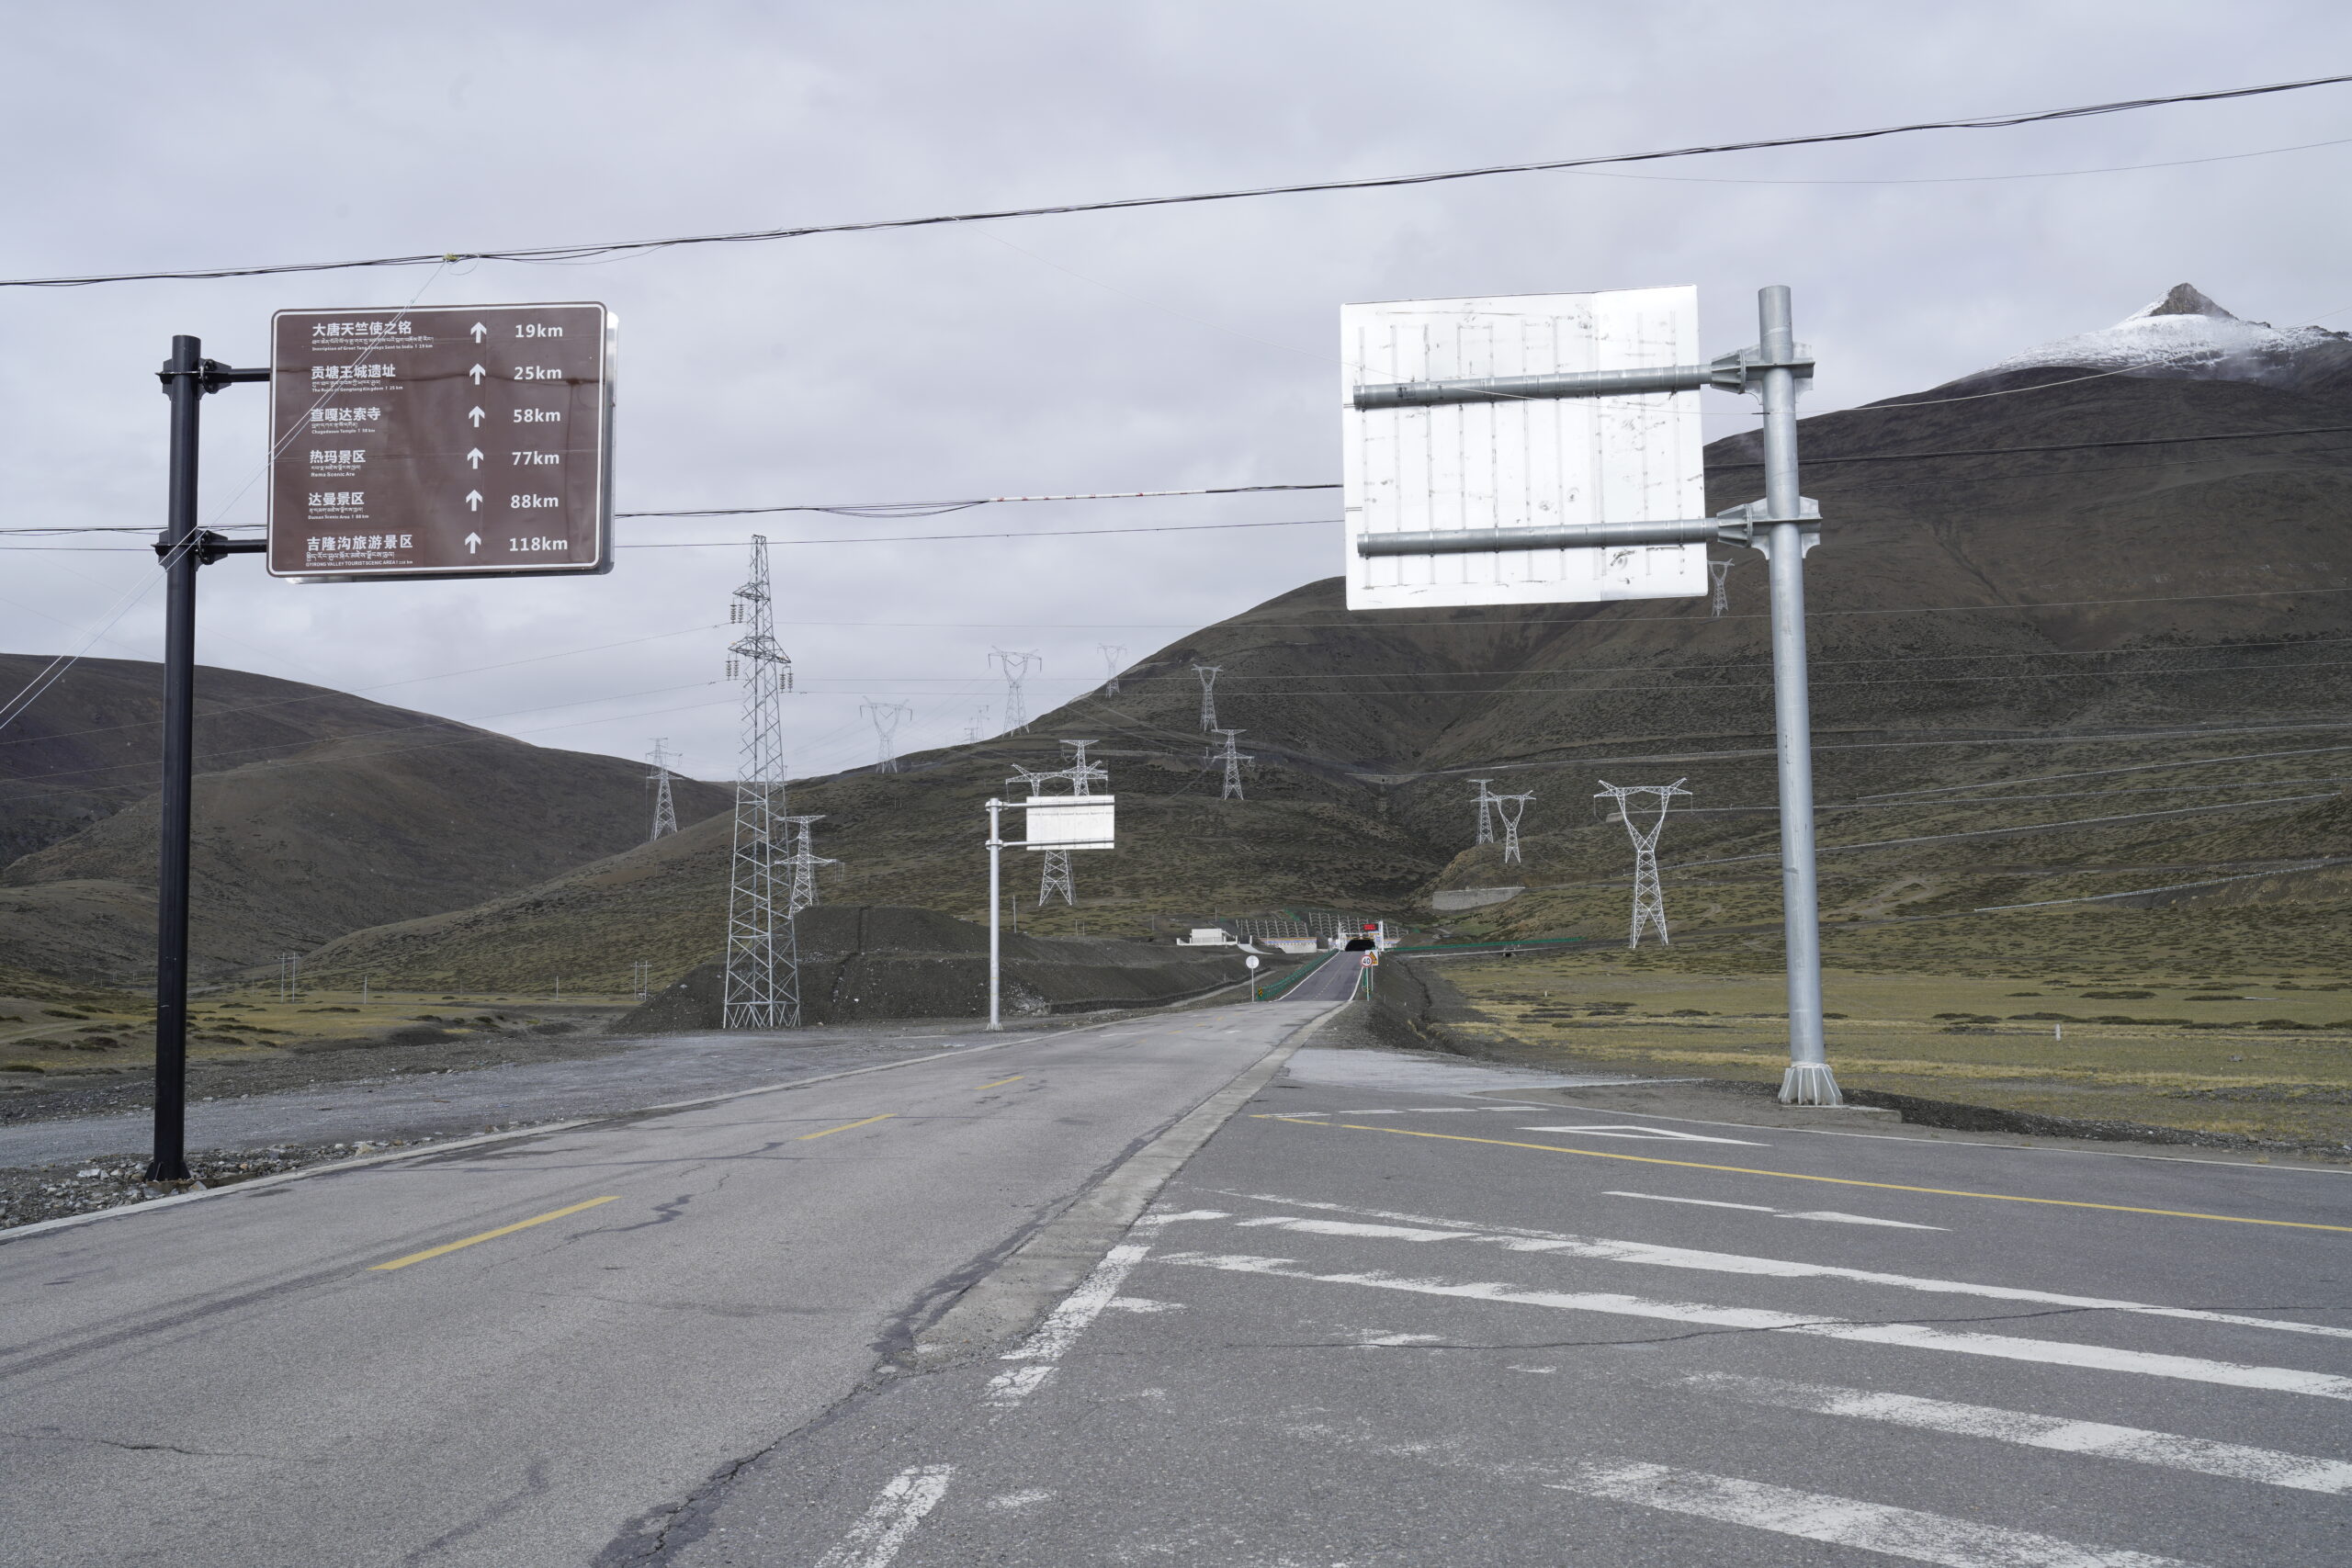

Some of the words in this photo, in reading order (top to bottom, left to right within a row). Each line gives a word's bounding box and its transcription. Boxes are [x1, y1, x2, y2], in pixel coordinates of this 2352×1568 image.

[312, 321, 412, 336] 大唐天竺使之铭
[515, 323, 563, 338] 19km
[311, 364, 396, 379] 贡塘王城遗址
[514, 366, 562, 380] 25km
[311, 407, 381, 422] 查嘎达索寺
[513, 409, 560, 423] 58km
[310, 449, 366, 464] 热玛景区
[512, 451, 560, 465] 77km
[308, 491, 365, 506] 达曼景区
[511, 494, 559, 508] 88km
[307, 534, 413, 551] 吉隆沟旅游景区
[509, 536, 568, 551] 118km
